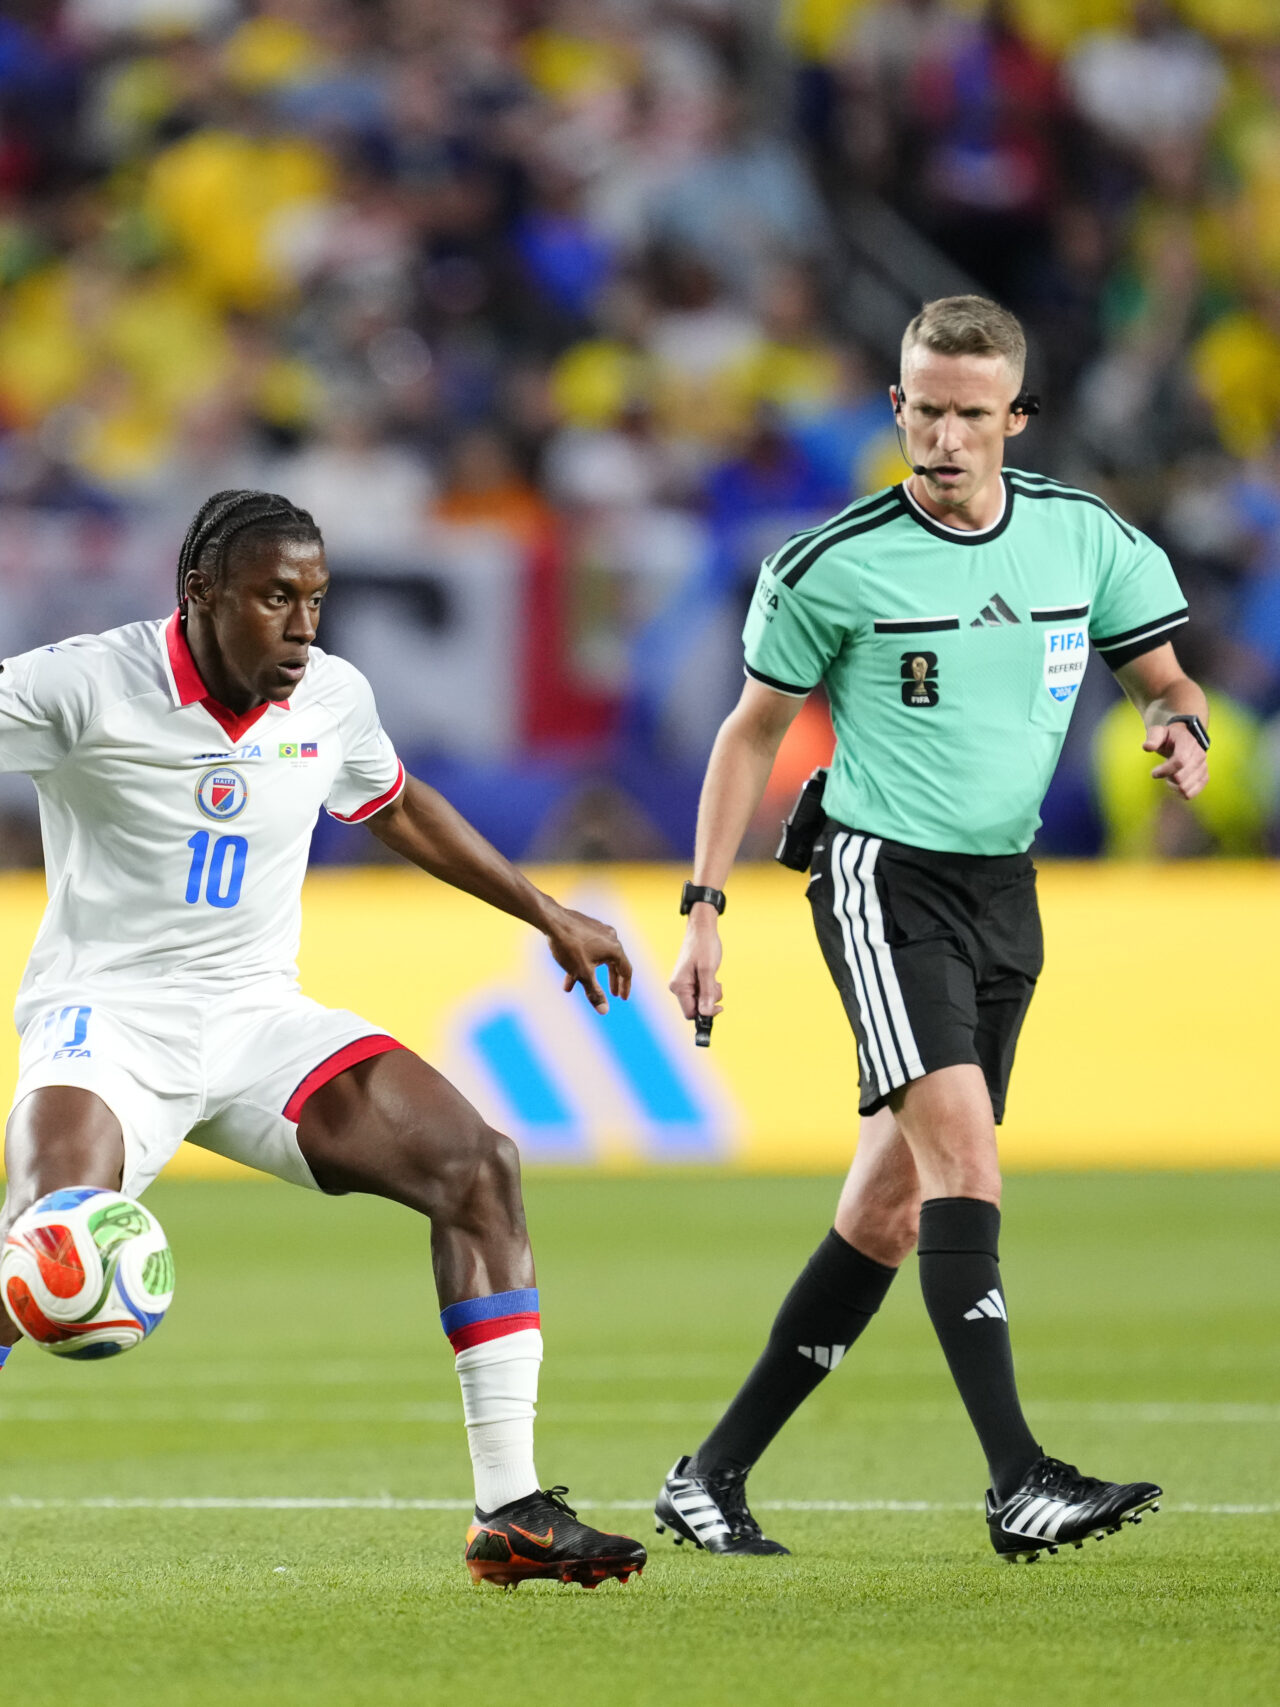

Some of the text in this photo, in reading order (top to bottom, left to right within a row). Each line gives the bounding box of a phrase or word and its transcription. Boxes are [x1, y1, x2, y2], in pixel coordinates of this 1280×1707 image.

[1050, 632, 1085, 652] FIFA
[185, 830, 249, 908] 10
[53, 1049, 91, 1059] ETA
